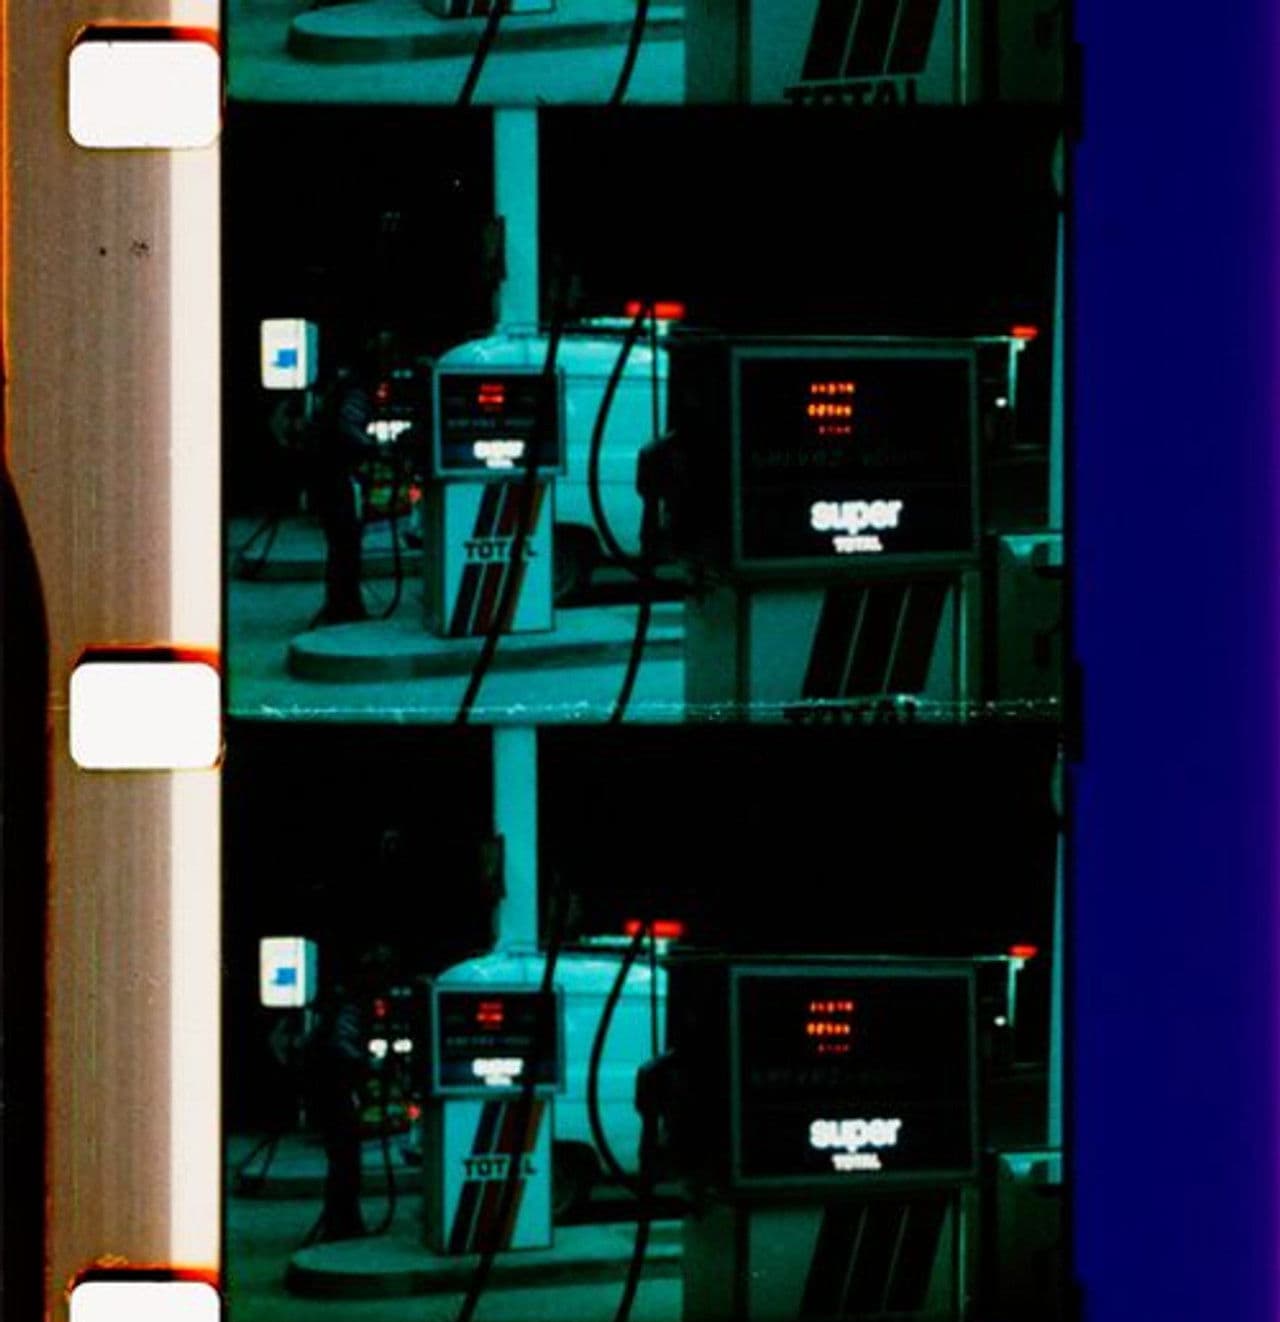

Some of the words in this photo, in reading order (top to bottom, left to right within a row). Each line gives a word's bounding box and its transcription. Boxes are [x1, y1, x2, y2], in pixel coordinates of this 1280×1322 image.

[810, 500, 903, 535] super
[463, 540, 538, 559] TOTL
[809, 1118, 902, 1153] super
[463, 1158, 537, 1177] TOTL
